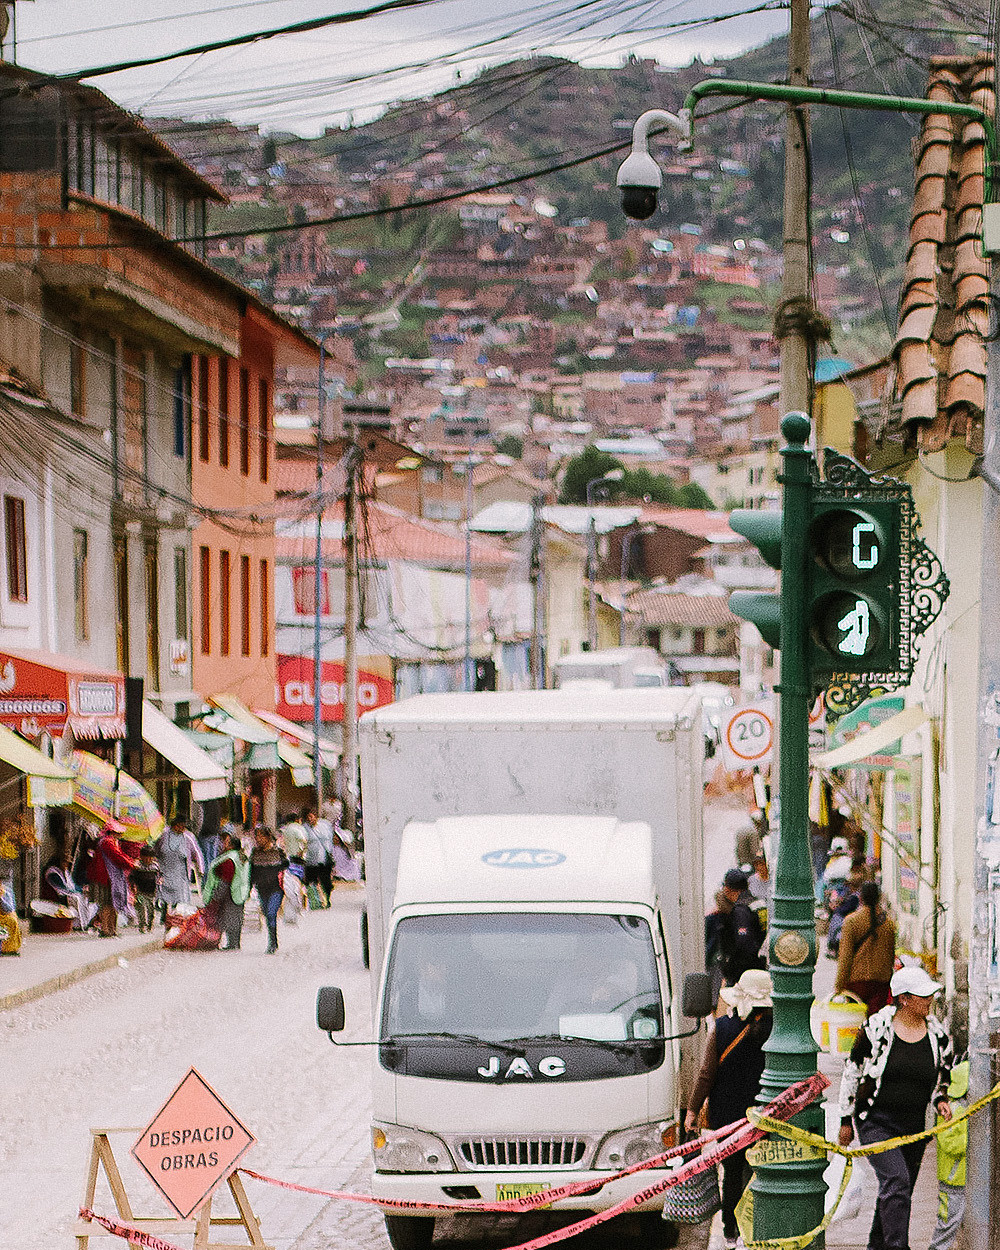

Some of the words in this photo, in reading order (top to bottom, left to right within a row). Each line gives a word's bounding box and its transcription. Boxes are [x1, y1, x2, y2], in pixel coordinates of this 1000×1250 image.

[285, 681, 378, 705] CUSO
[737, 719, 764, 741] 20
[487, 851, 559, 864] JAC
[477, 1056, 566, 1079] JAC
[149, 1125, 235, 1148] DESPACIO
[160, 1151, 219, 1172] OBRAS
[632, 1176, 680, 1206] OBRAS
